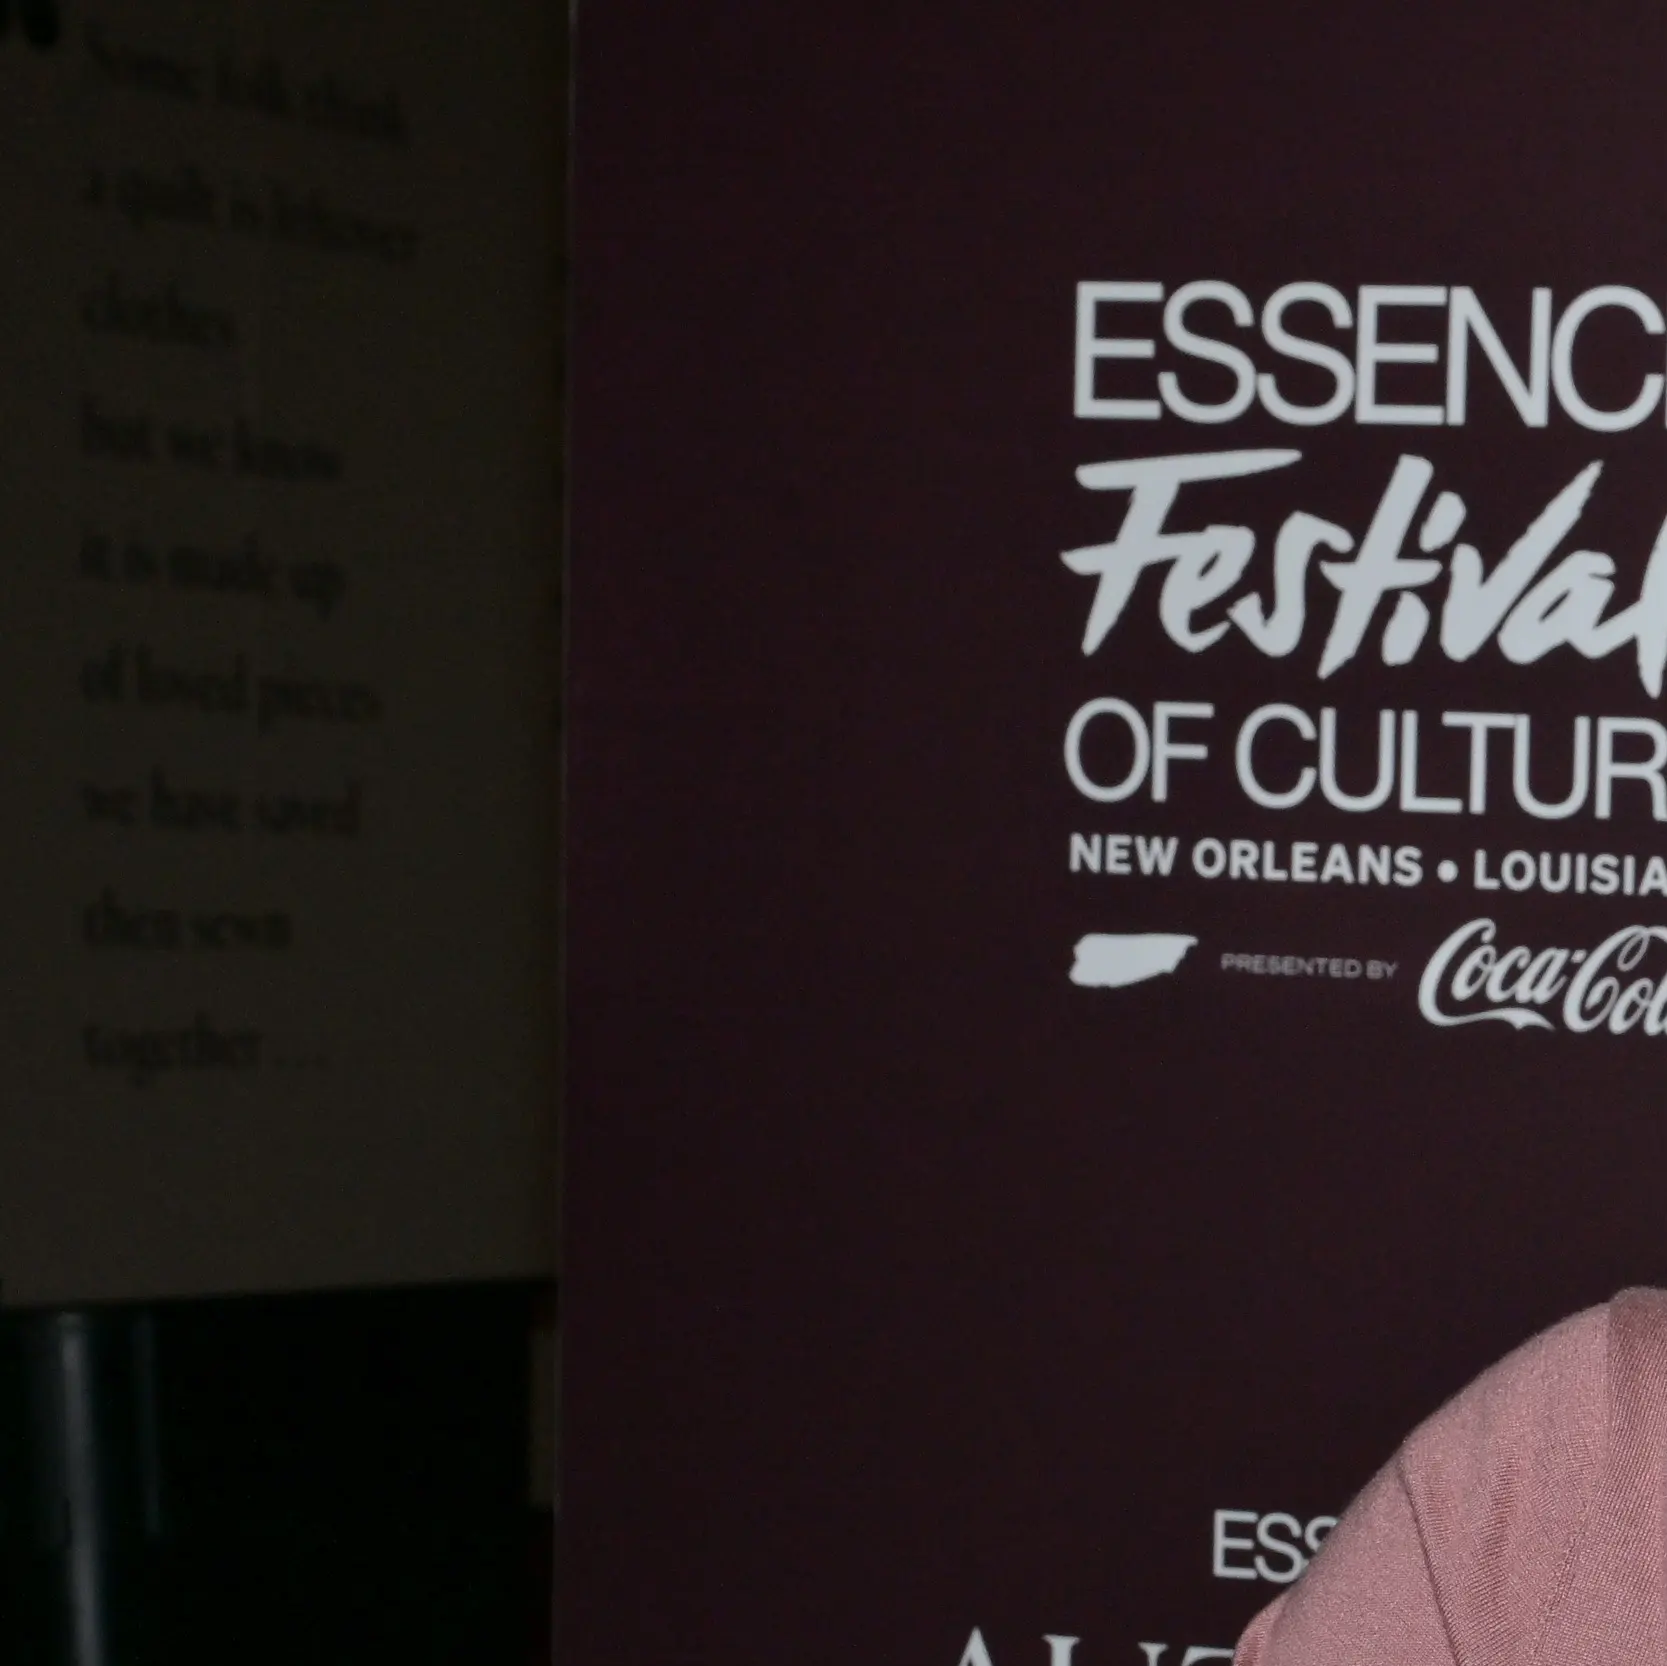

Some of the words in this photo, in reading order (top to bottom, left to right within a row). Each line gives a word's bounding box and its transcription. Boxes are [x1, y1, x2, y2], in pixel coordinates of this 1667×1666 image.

[1064, 698, 1214, 802] OF
[1069, 833, 1179, 878] NEW
[1191, 838, 1423, 887] ORLEANS
[1221, 954, 1361, 979] PRESENTED
[1366, 961, 1398, 980] BY
